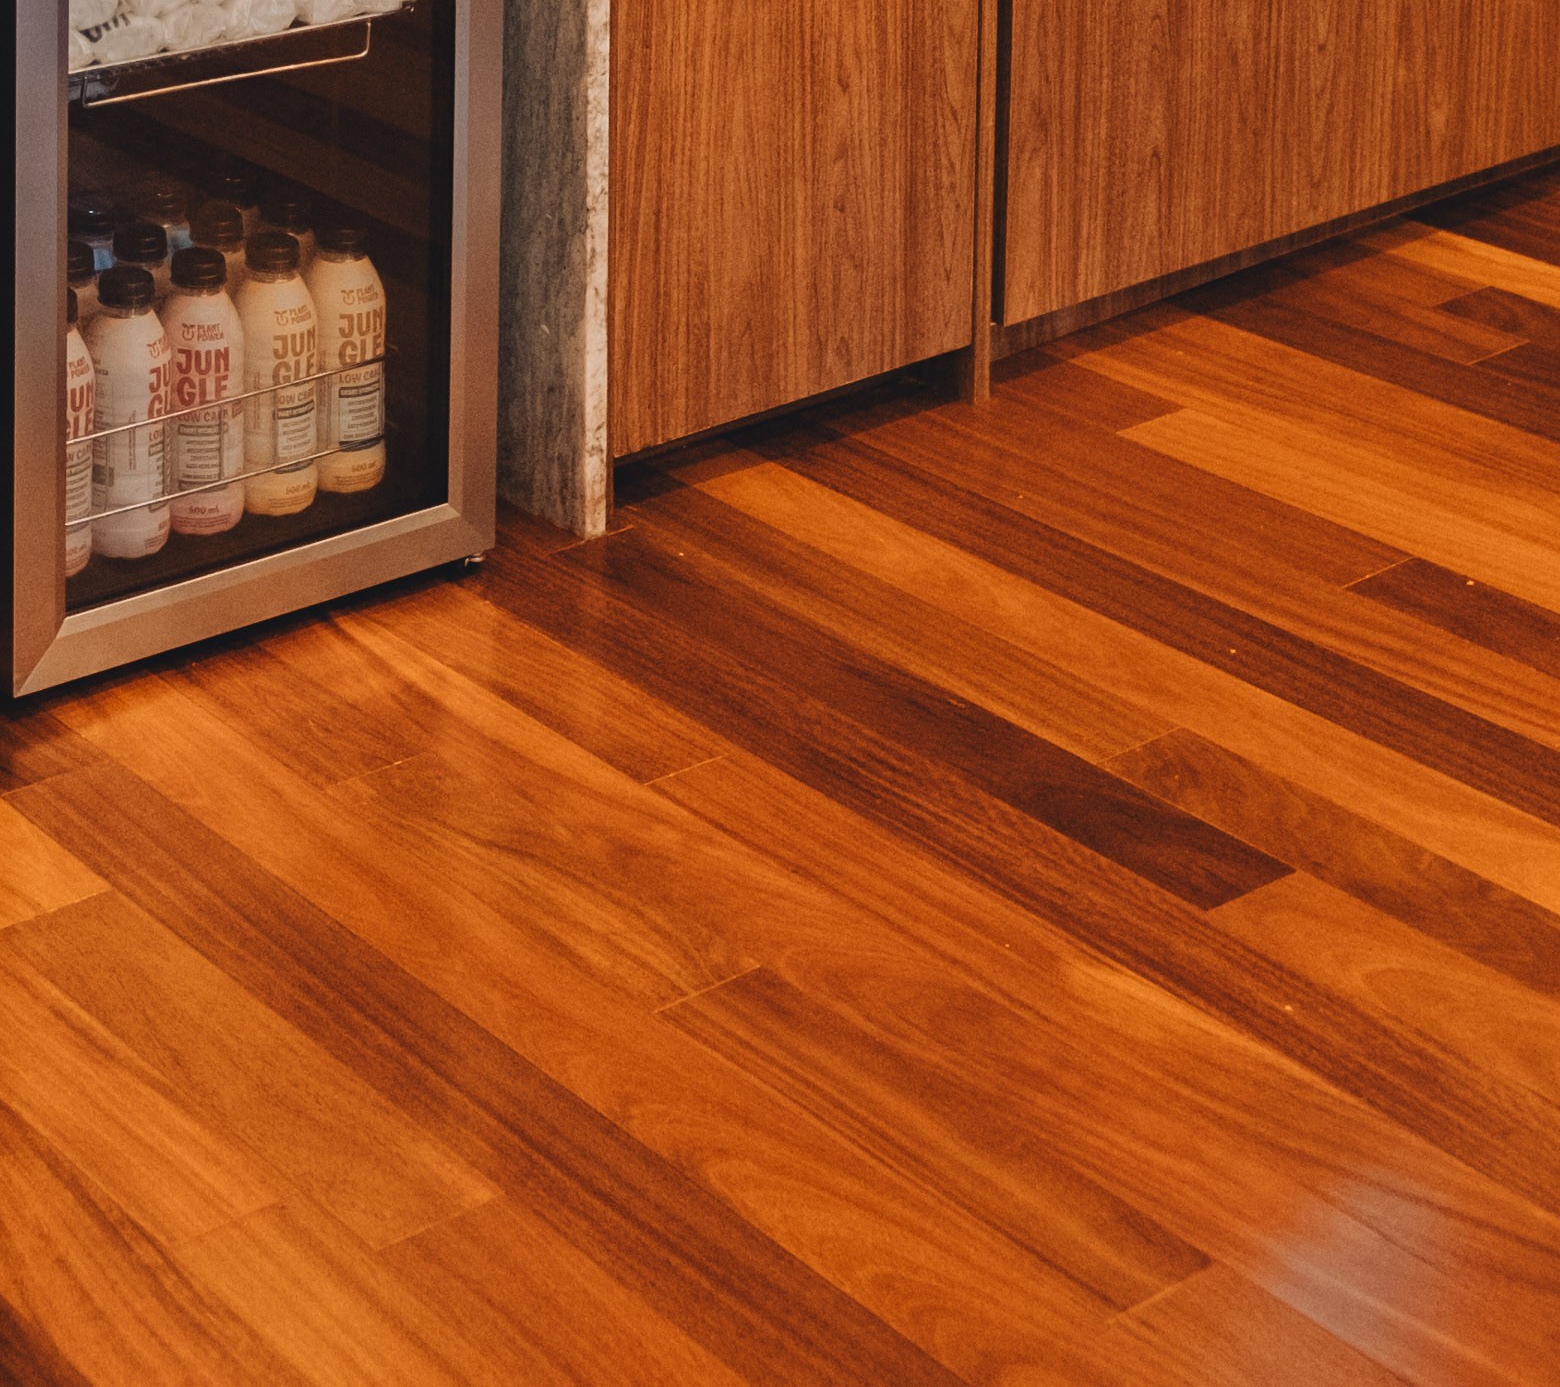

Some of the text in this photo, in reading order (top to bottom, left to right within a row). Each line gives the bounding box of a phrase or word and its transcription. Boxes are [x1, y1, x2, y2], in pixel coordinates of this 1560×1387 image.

[149, 359, 172, 394] JU
[176, 346, 230, 375] JUN
[70, 380, 95, 413] UN
[176, 373, 229, 407] GLE
